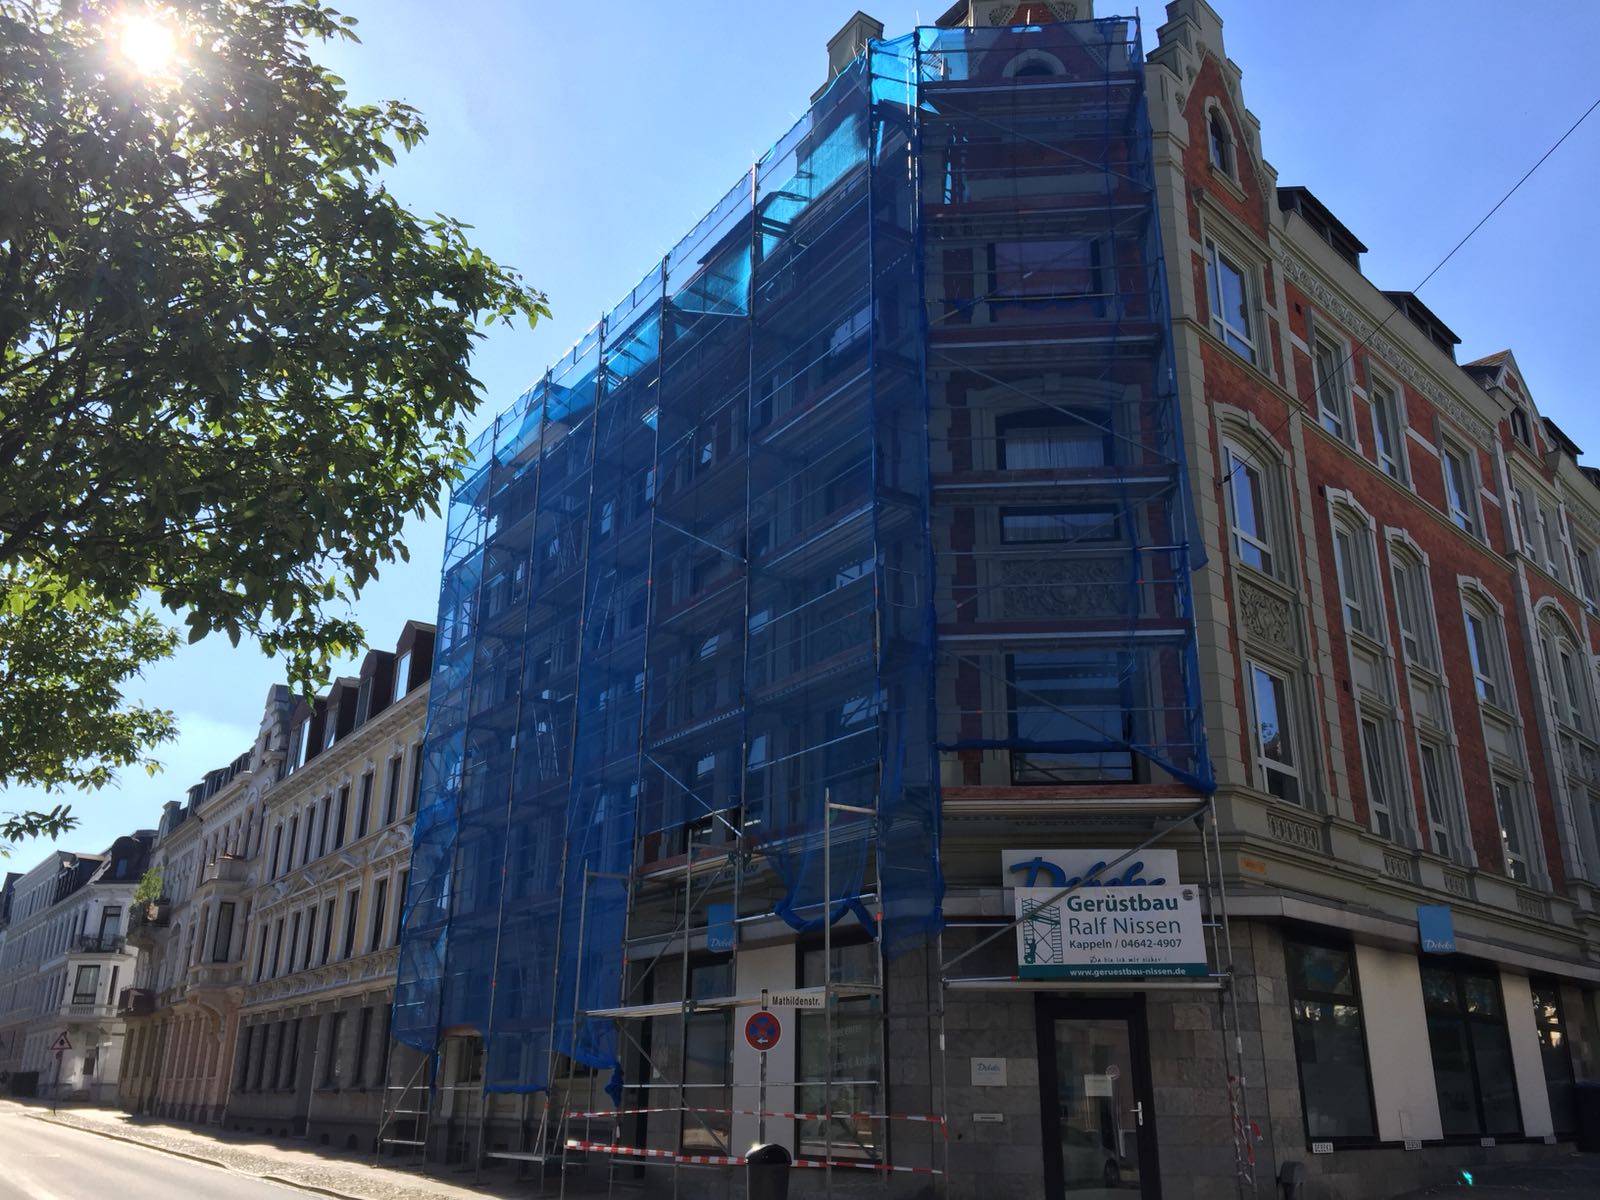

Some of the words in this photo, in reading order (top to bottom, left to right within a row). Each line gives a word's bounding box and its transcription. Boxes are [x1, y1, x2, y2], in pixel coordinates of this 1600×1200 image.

[1066, 894, 1178, 912] Gerüstbau
[1069, 916, 1108, 935] Ralf
[1114, 917, 1182, 934] Nissen
[1069, 939, 1112, 951] Kappeln
[1121, 938, 1182, 949] 04642-4907
[1069, 967, 1186, 977] www.geruestbau-nissen.de
[772, 995, 821, 1006] Mathildenstr.
